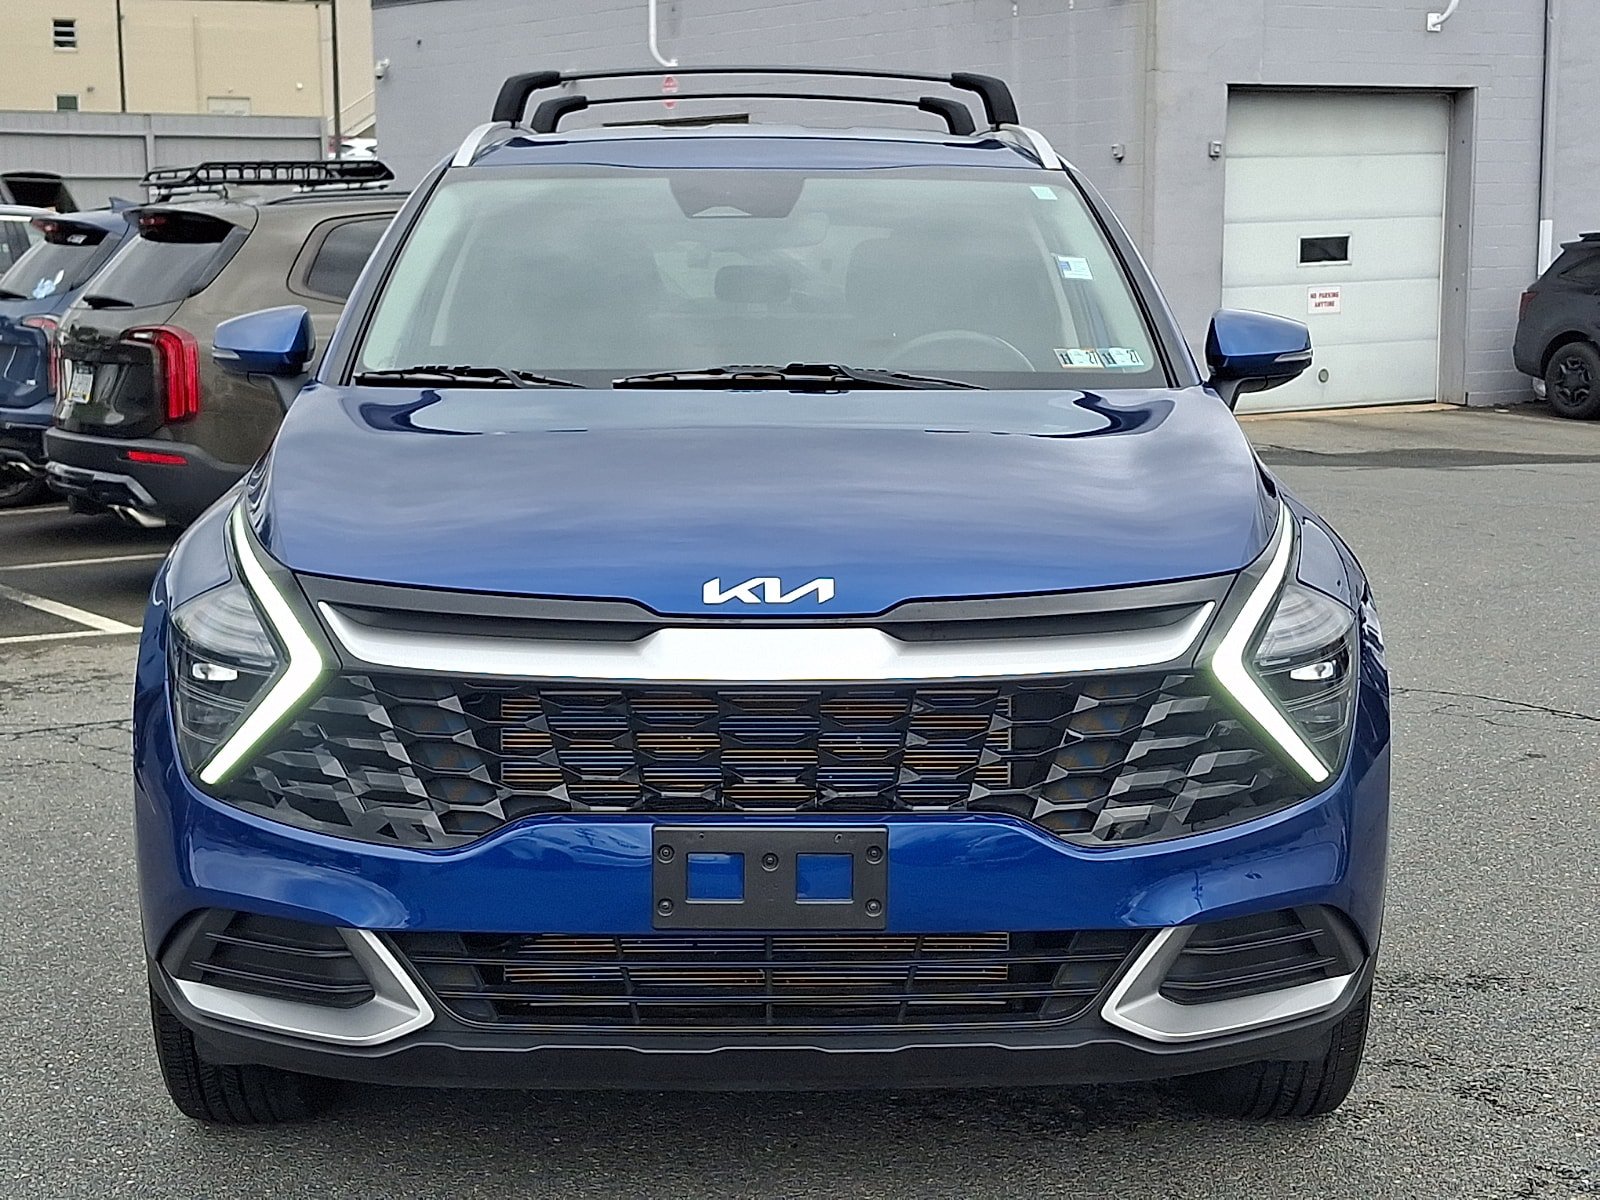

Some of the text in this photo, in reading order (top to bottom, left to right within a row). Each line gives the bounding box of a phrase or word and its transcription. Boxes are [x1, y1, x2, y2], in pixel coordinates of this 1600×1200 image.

[1086, 351, 1099, 365] 27
[1126, 349, 1140, 364] 27
[702, 577, 835, 604] KIA
